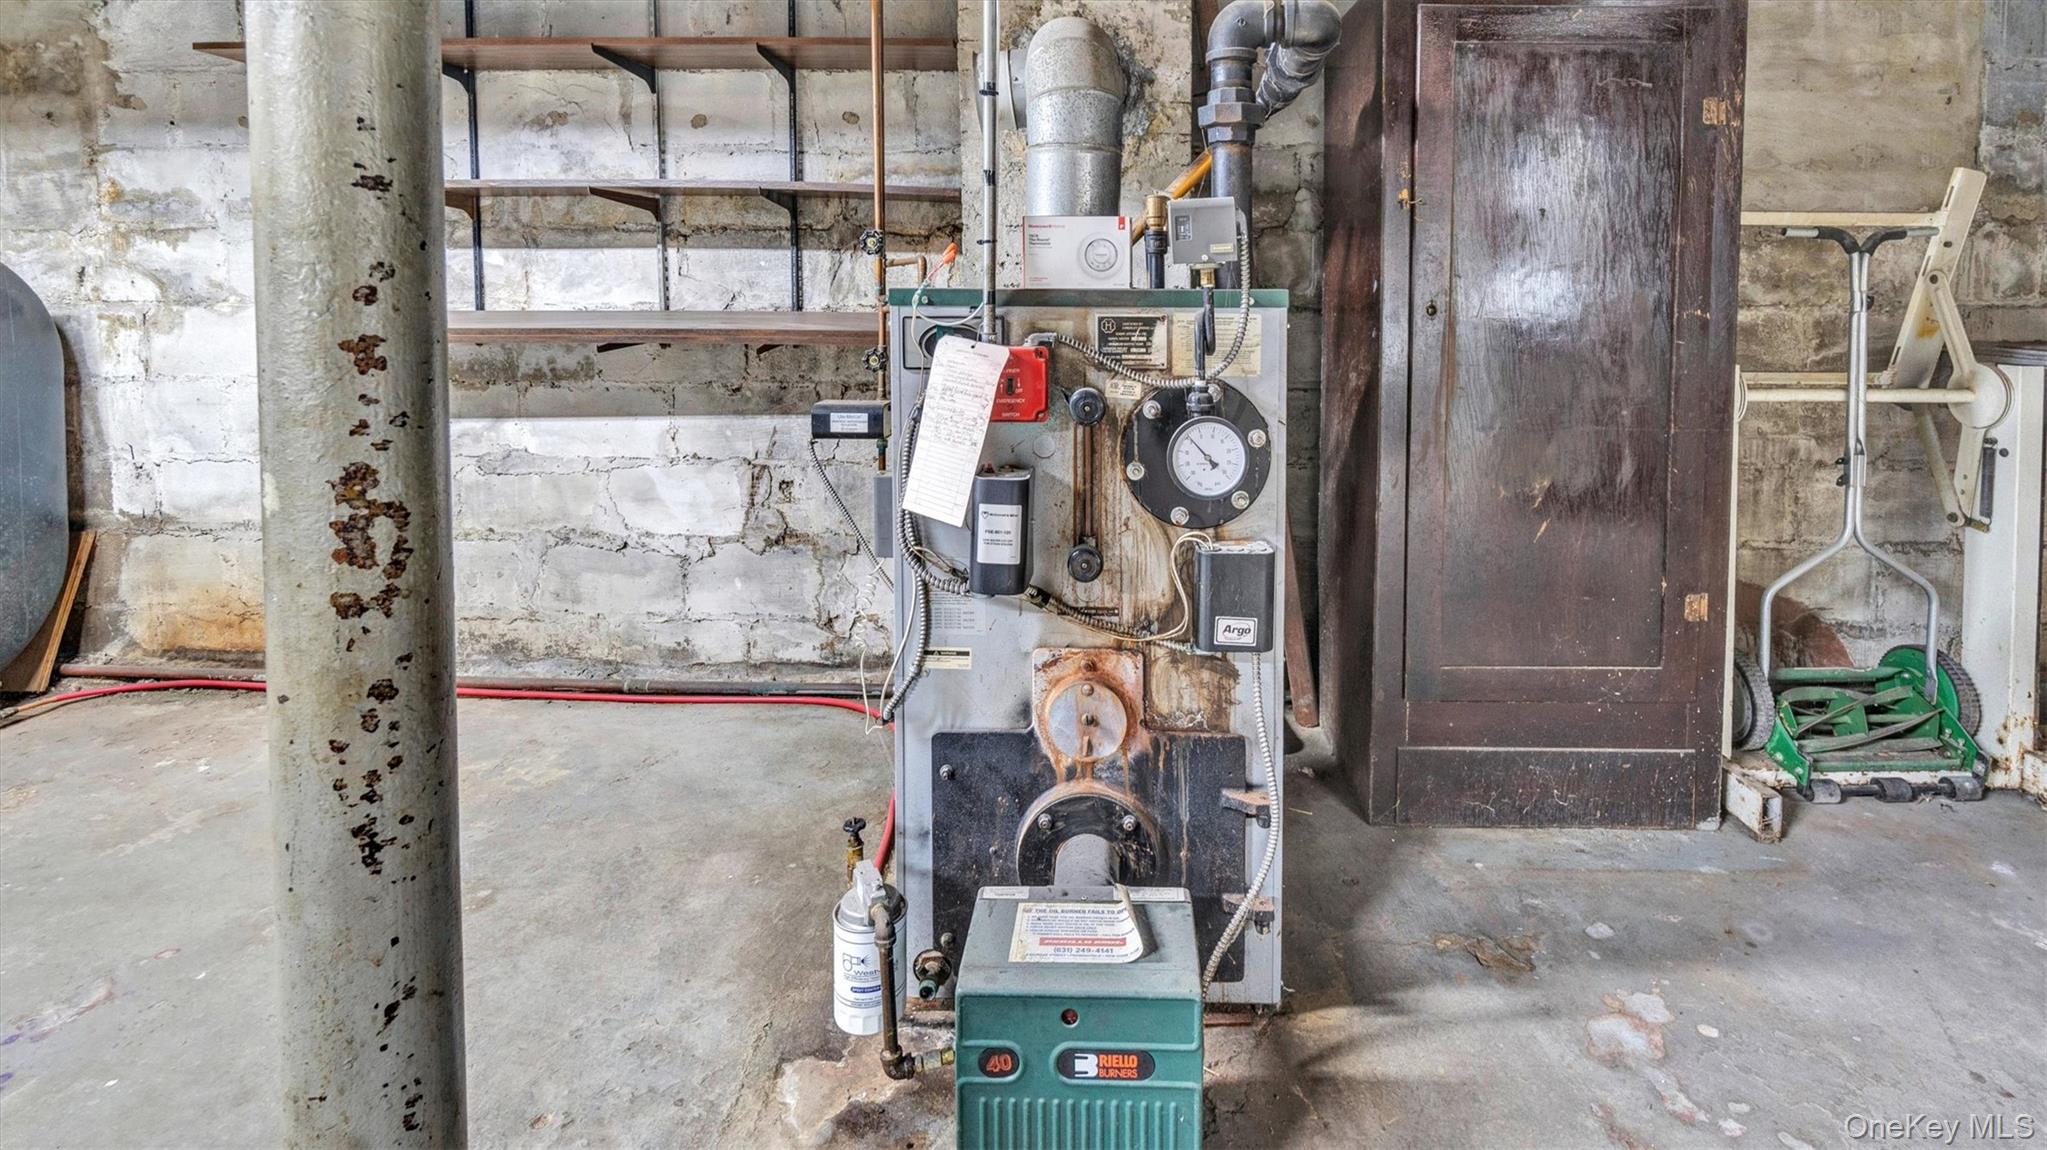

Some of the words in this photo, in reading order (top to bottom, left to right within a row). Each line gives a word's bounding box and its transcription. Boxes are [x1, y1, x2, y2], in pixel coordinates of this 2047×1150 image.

[1223, 625, 1251, 636] Argo
[985, 1054, 1013, 1073] 40
[1098, 1054, 1138, 1069] RIELLO
[1098, 1068, 1138, 1079] BURNERS
